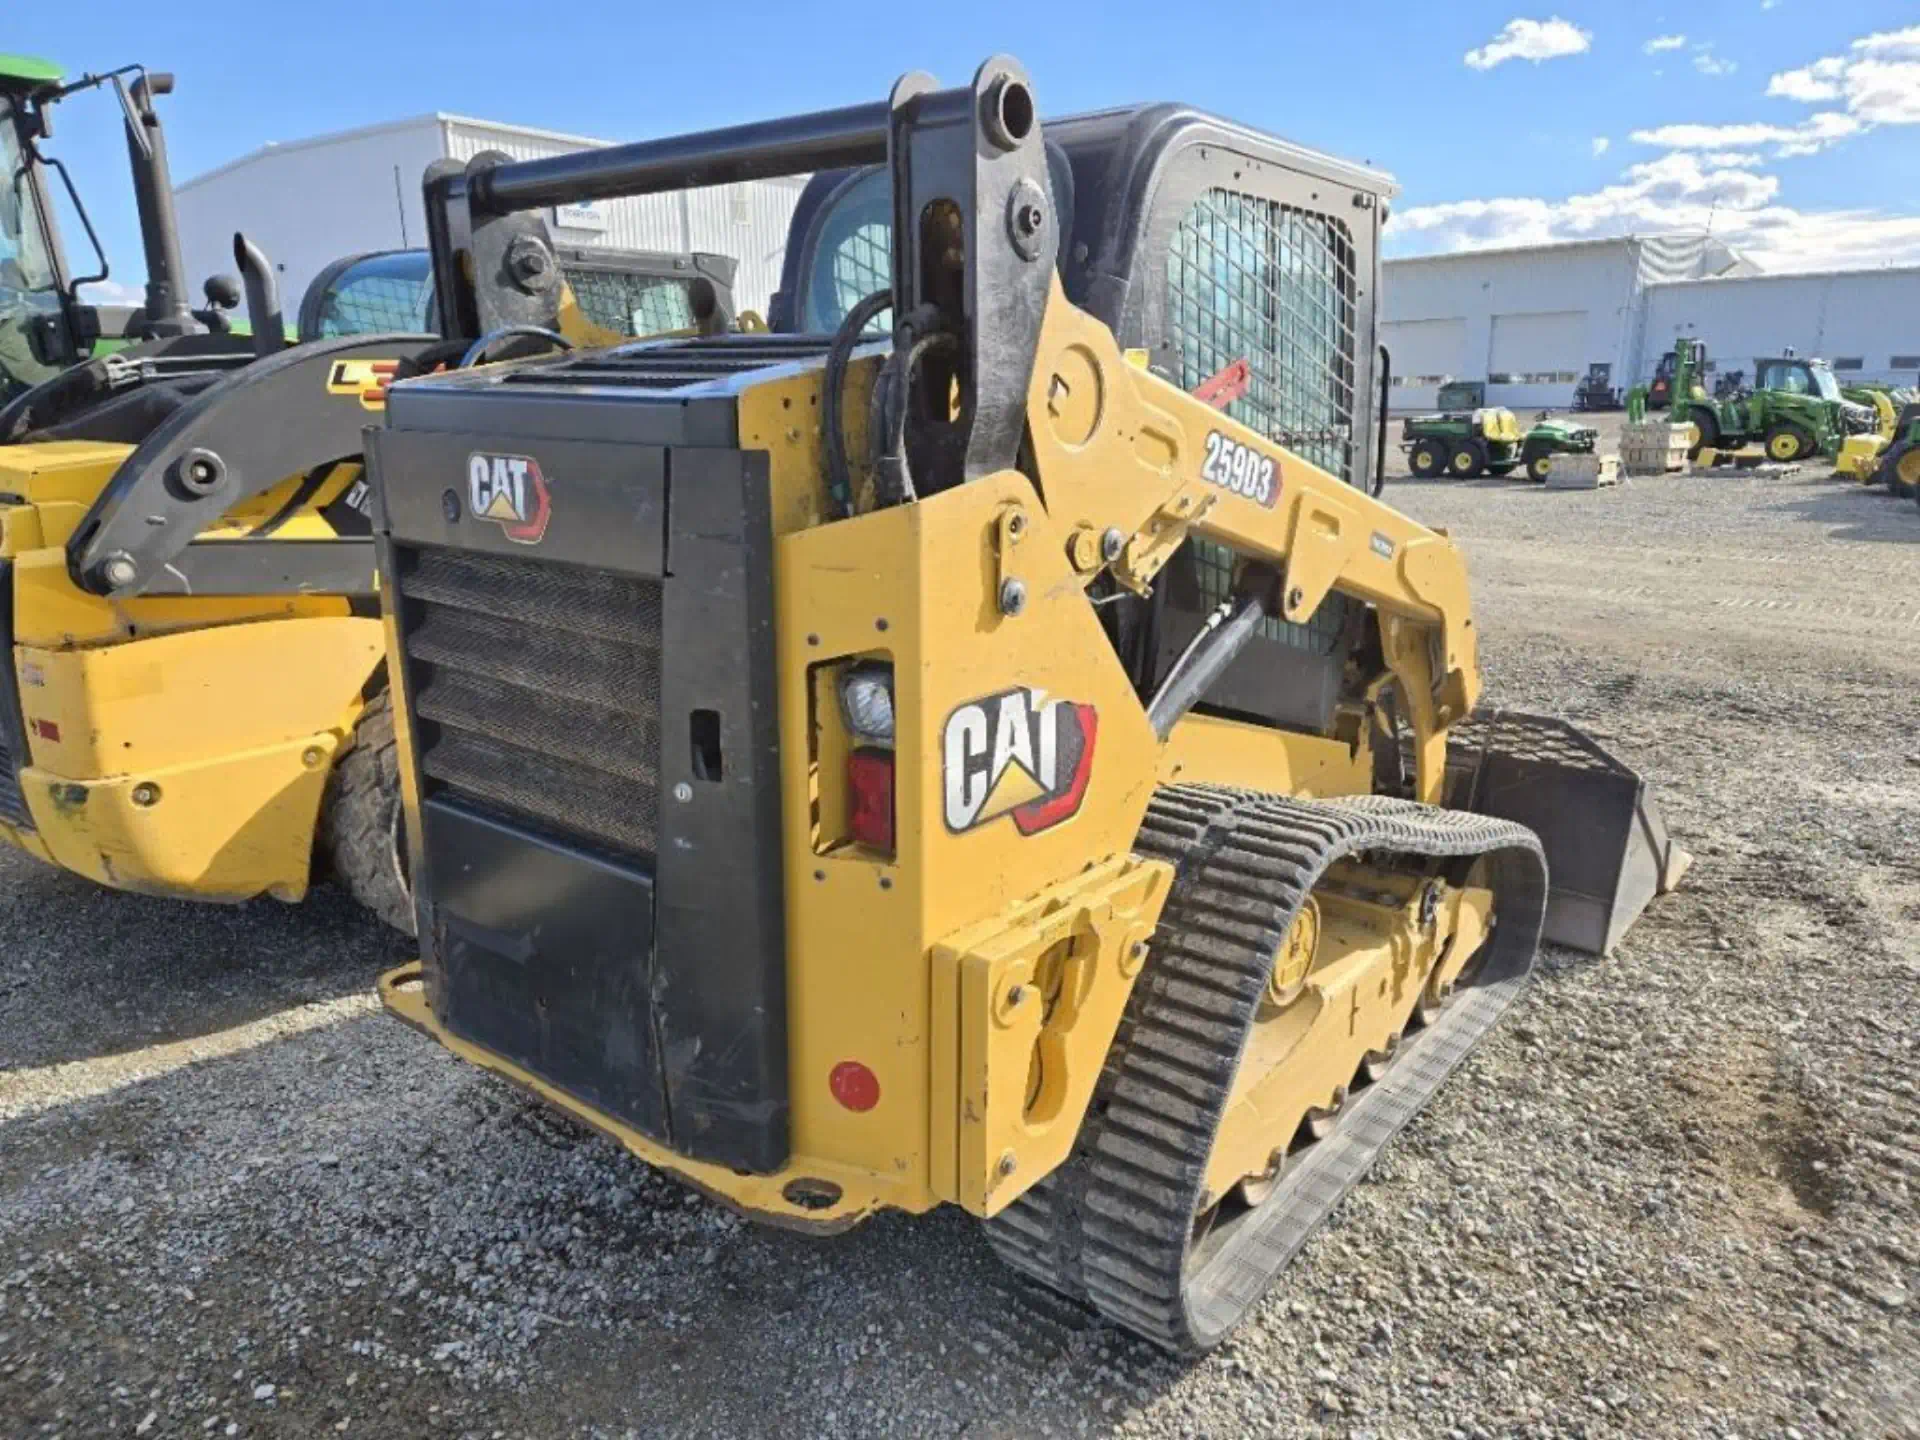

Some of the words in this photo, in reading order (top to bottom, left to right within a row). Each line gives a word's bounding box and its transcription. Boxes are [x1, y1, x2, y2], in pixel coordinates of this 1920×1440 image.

[470, 455, 528, 521] CAT
[1202, 431, 1273, 504] 259D3
[945, 689, 1057, 830] CAT
